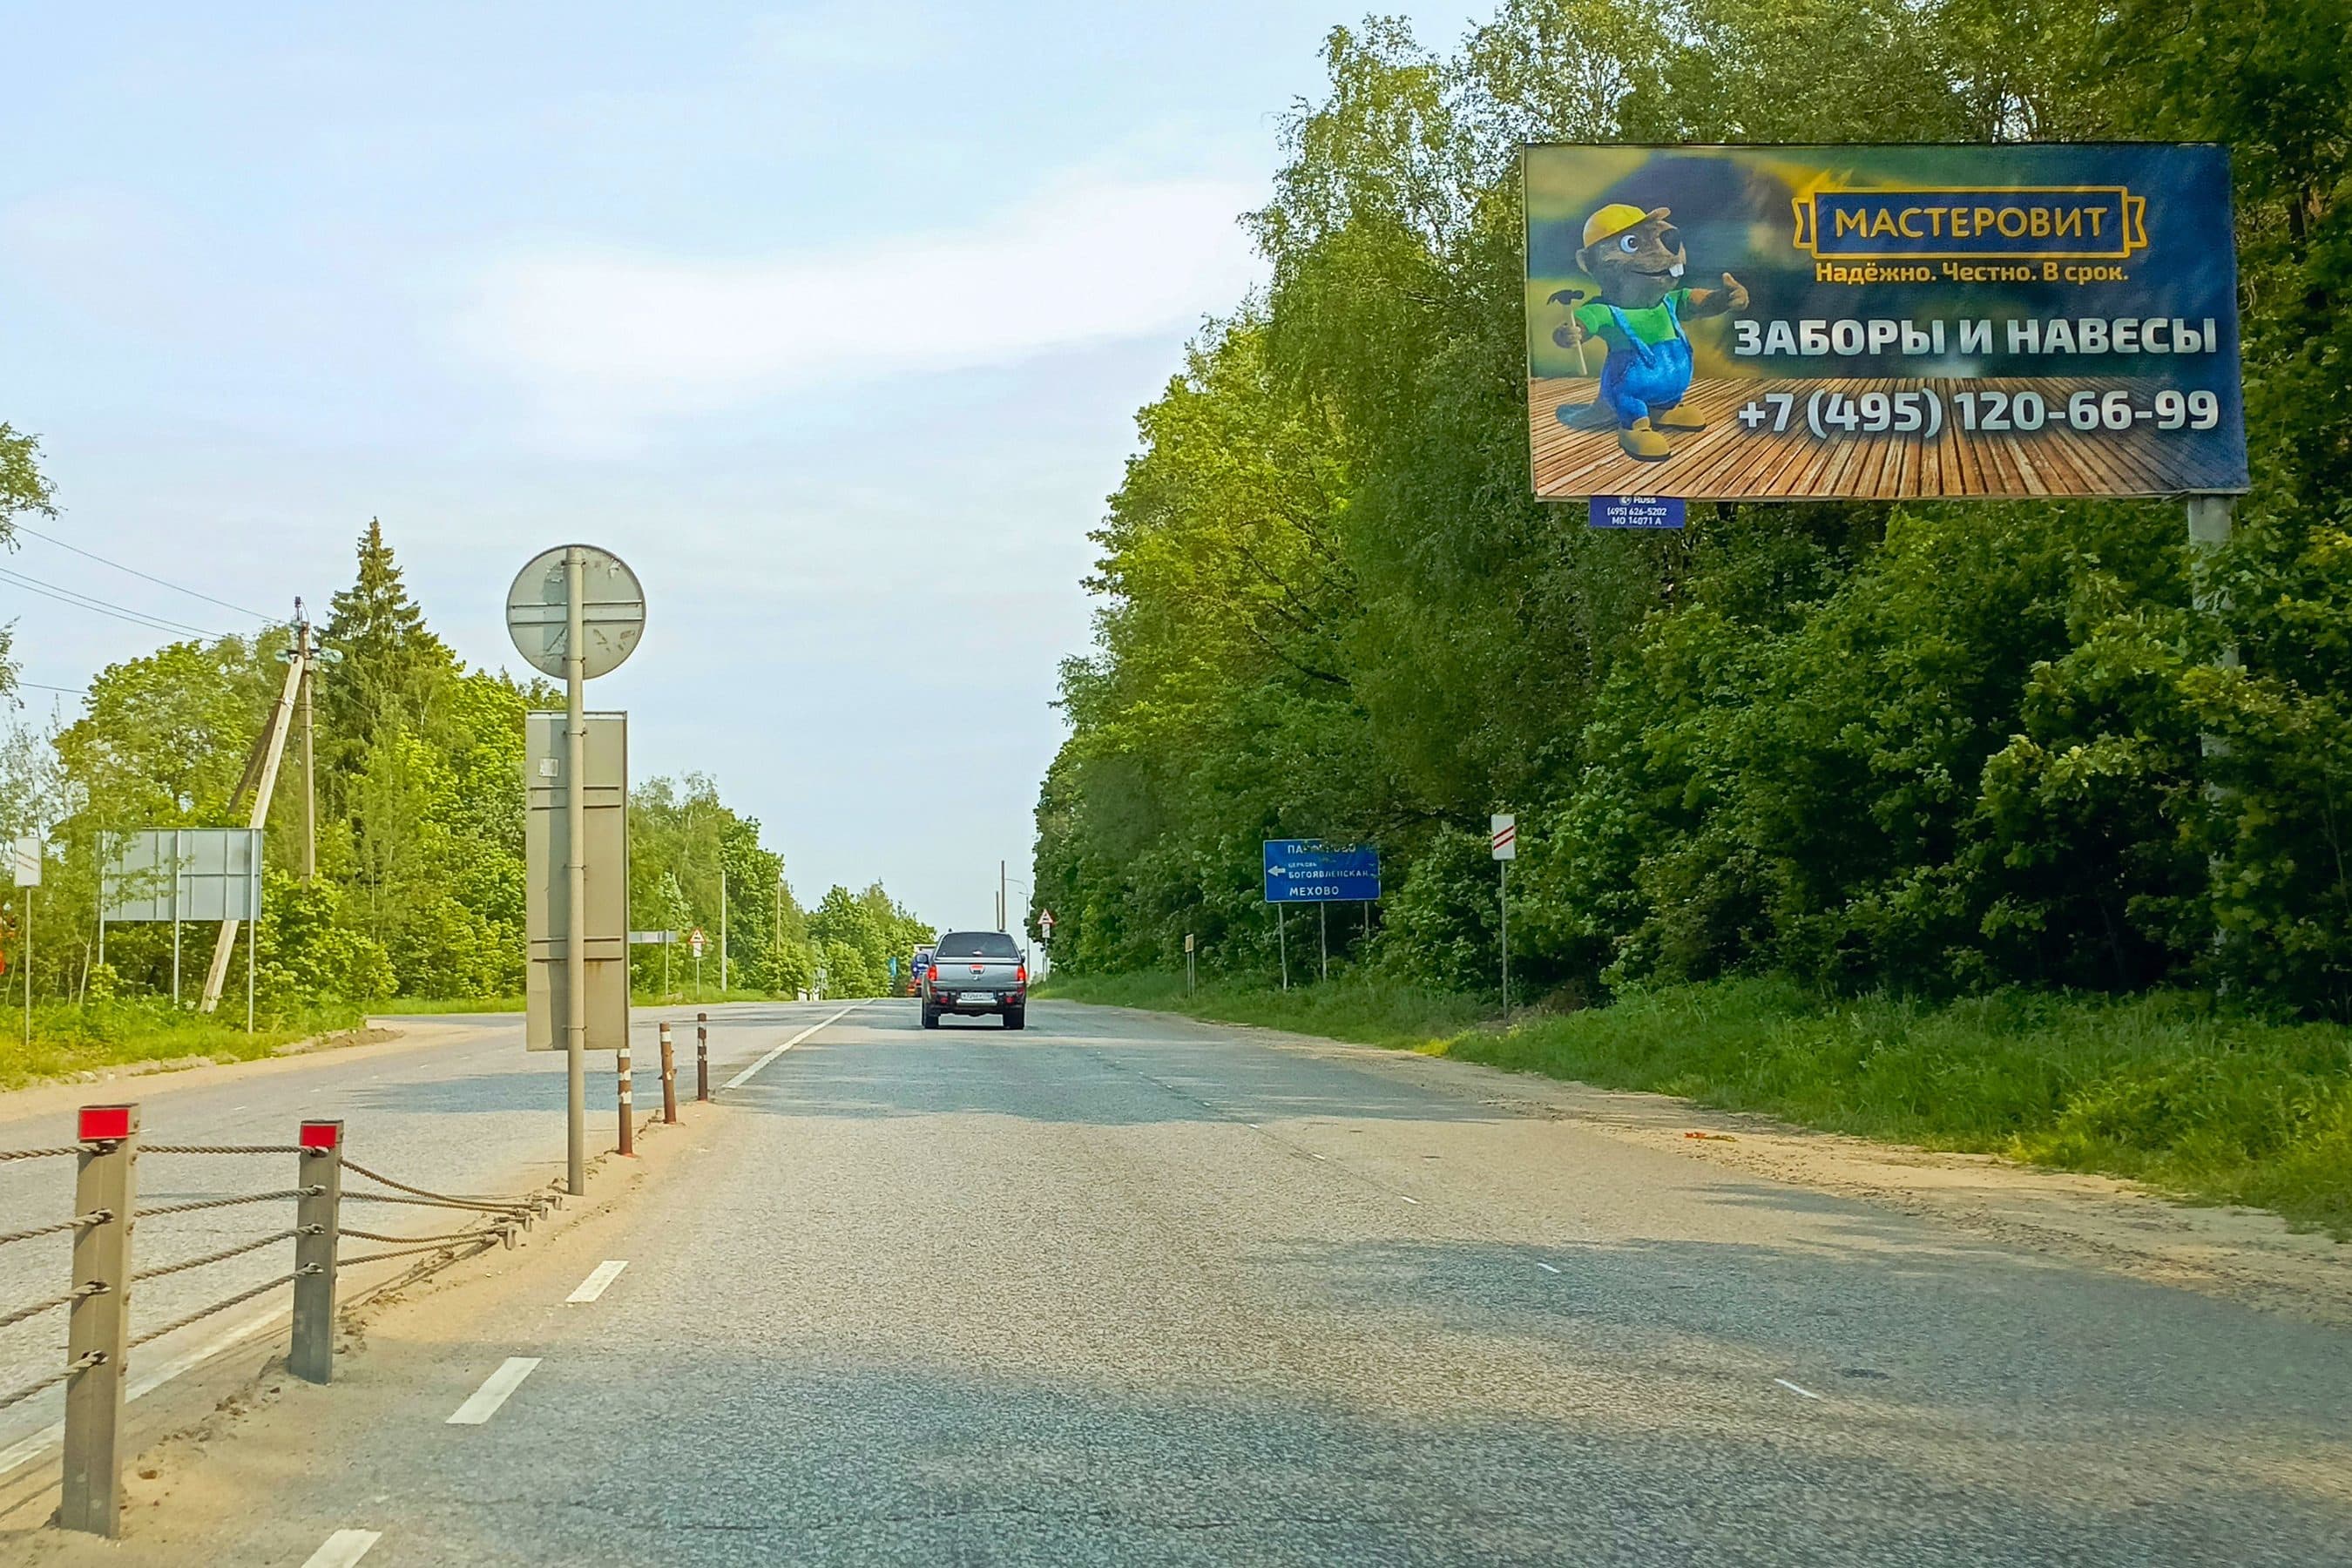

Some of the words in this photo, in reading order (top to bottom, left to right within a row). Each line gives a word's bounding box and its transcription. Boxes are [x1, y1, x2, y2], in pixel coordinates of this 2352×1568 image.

[1835, 207, 2108, 238] МАСТЕРОВИТ
[1816, 261, 1937, 285] Надёжно.
[1943, 262, 2038, 281] Честно.
[2043, 262, 2059, 280] В
[2064, 265, 2129, 286] срок.
[1734, 319, 1945, 356] ЗАБОРЫ
[1959, 319, 1993, 355] И
[2006, 317, 2218, 355] НАВЕСЫ
[1738, 394, 1794, 432] +7
[1807, 389, 1943, 439] (495)
[1953, 389, 2220, 431] 120-66-99
[1289, 886, 1340, 896] МЕХОВО
